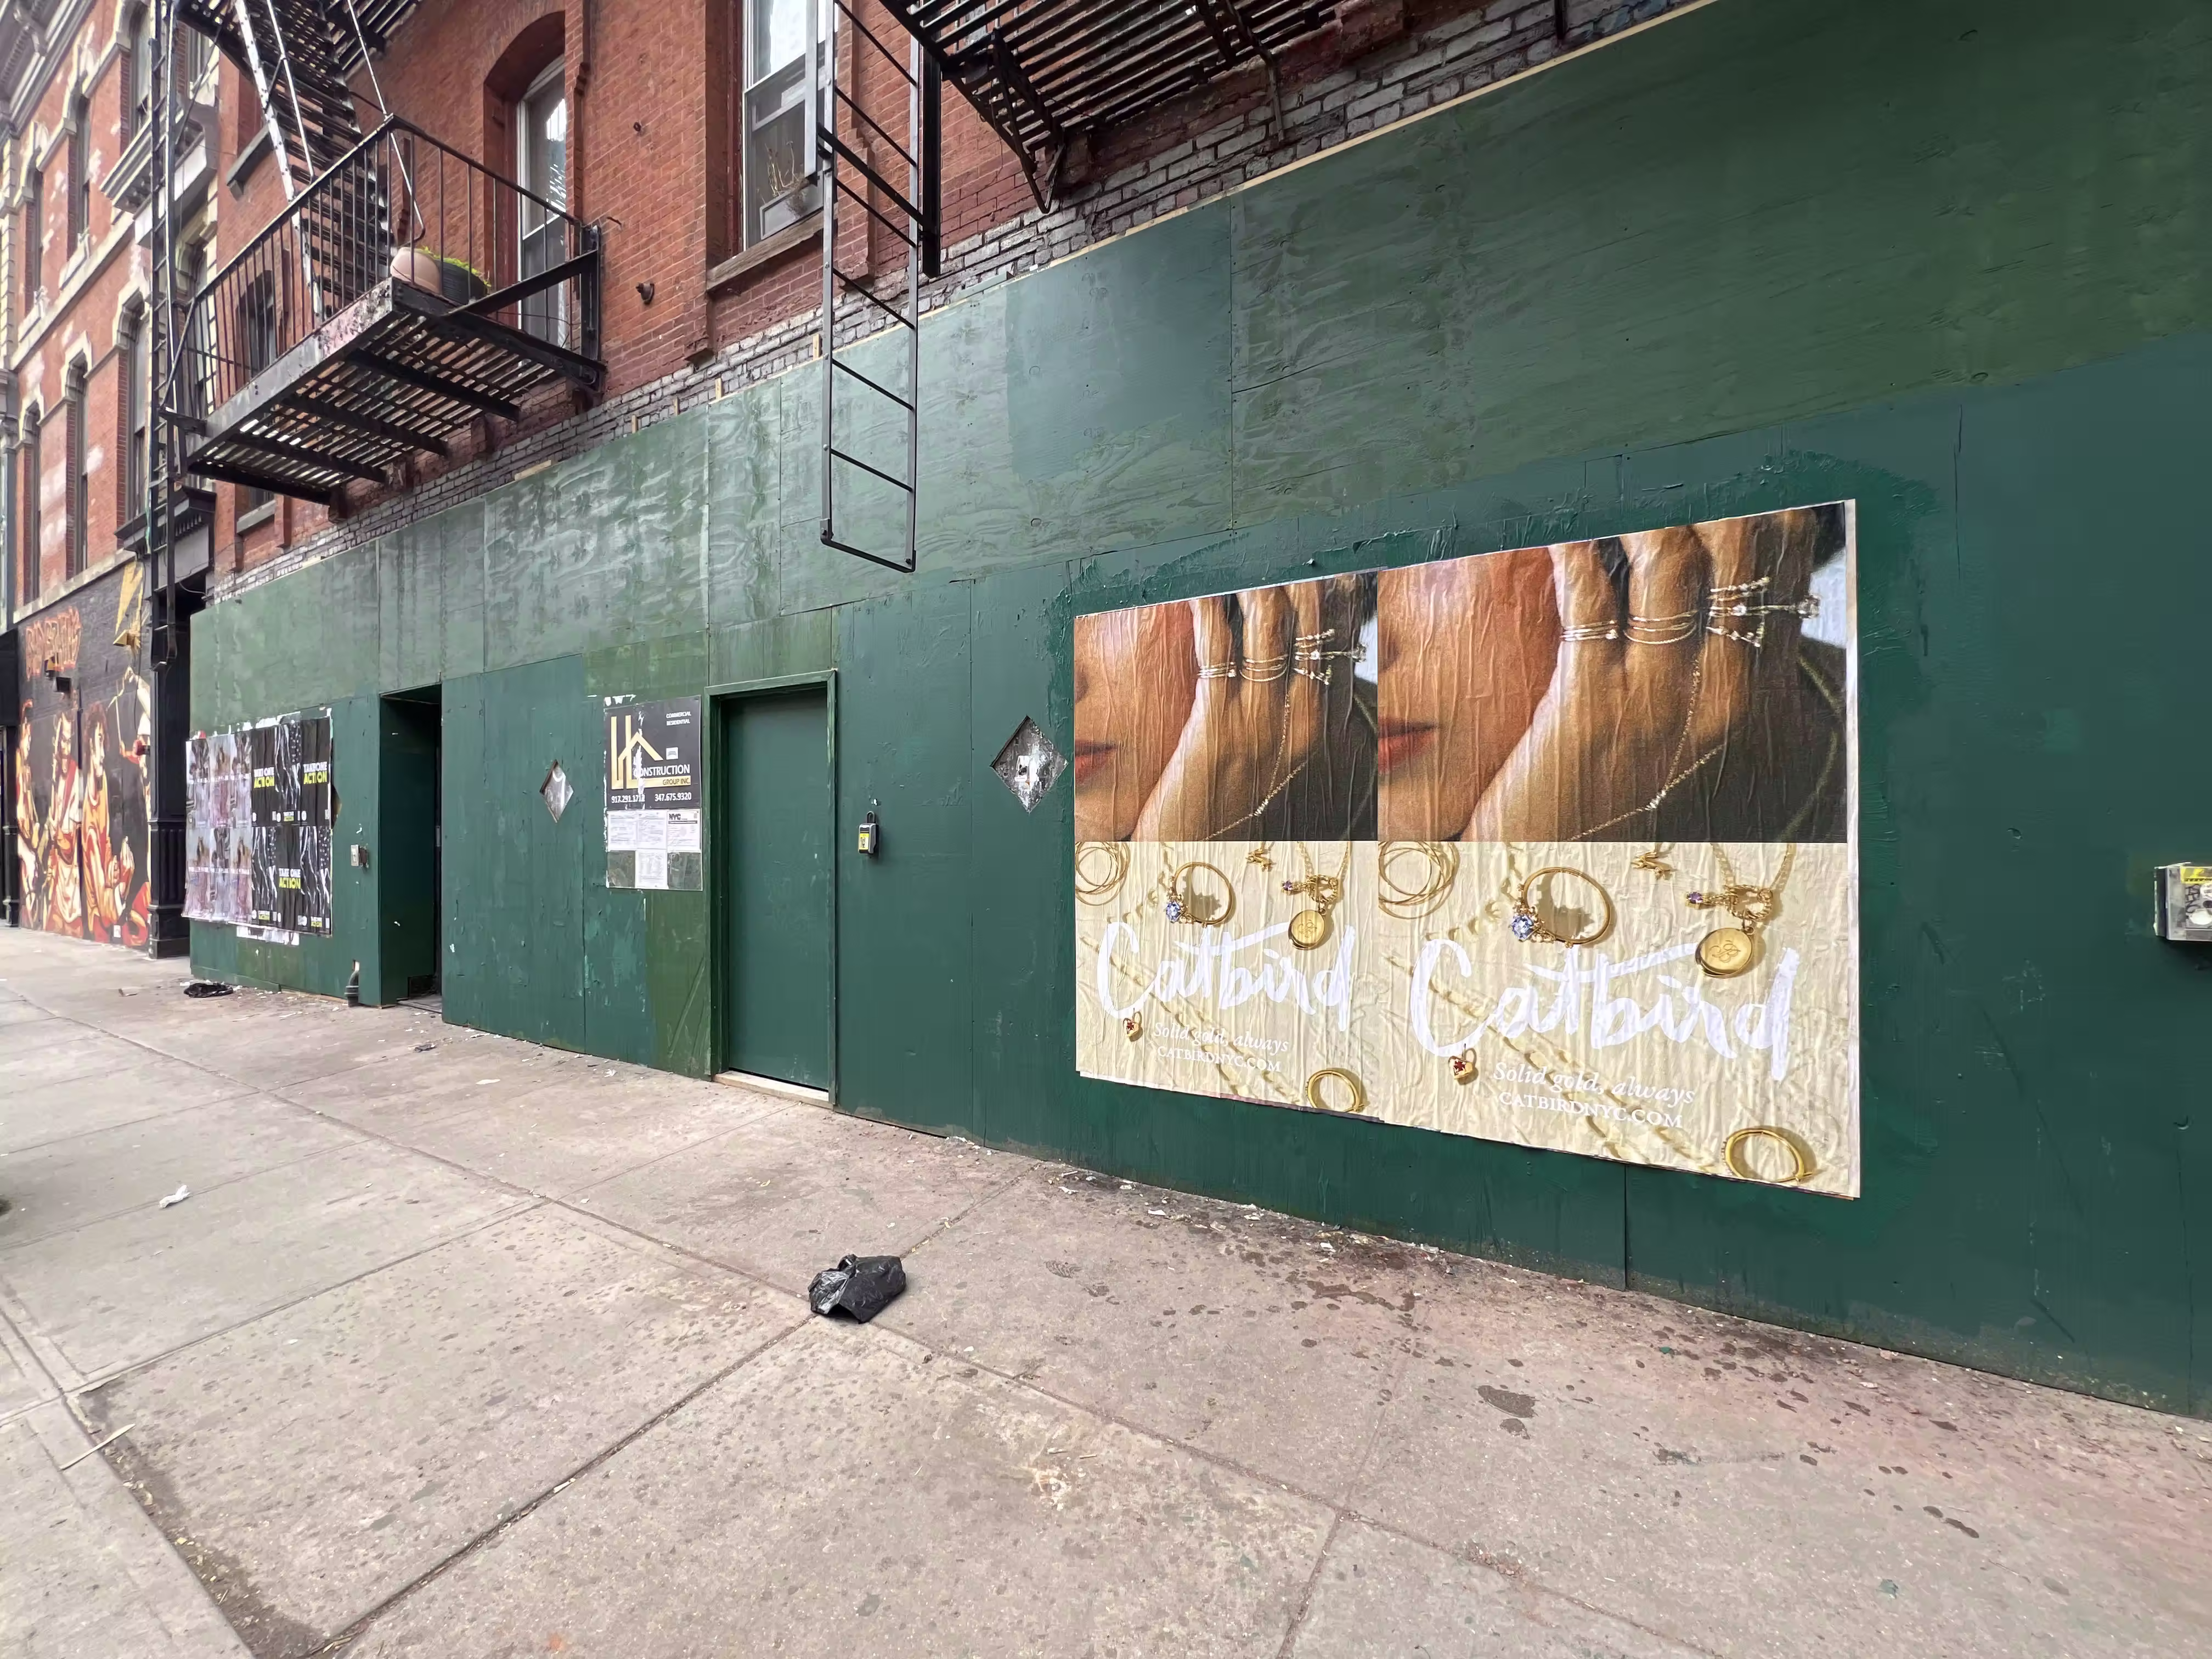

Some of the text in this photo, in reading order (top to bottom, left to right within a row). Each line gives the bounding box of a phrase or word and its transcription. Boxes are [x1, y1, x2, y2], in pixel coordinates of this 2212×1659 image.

[317, 761, 328, 771] ONE
[254, 776, 274, 788] ACTION
[303, 771, 328, 785] ACTION
[654, 792, 692, 802] 347.675.9320
[279, 877, 301, 889] ACTION
[290, 868, 301, 878] ONE
[1097, 921, 1356, 1032] Catbird
[1409, 938, 1800, 1081] Catbird
[1153, 1022, 1289, 1056] Solid gold, always
[1157, 1046, 1281, 1072] CATBIRDNYC.COM
[1493, 1062, 1696, 1108] Solid gold, always
[1499, 1091, 1683, 1128] CATBIRDNYC.COM
